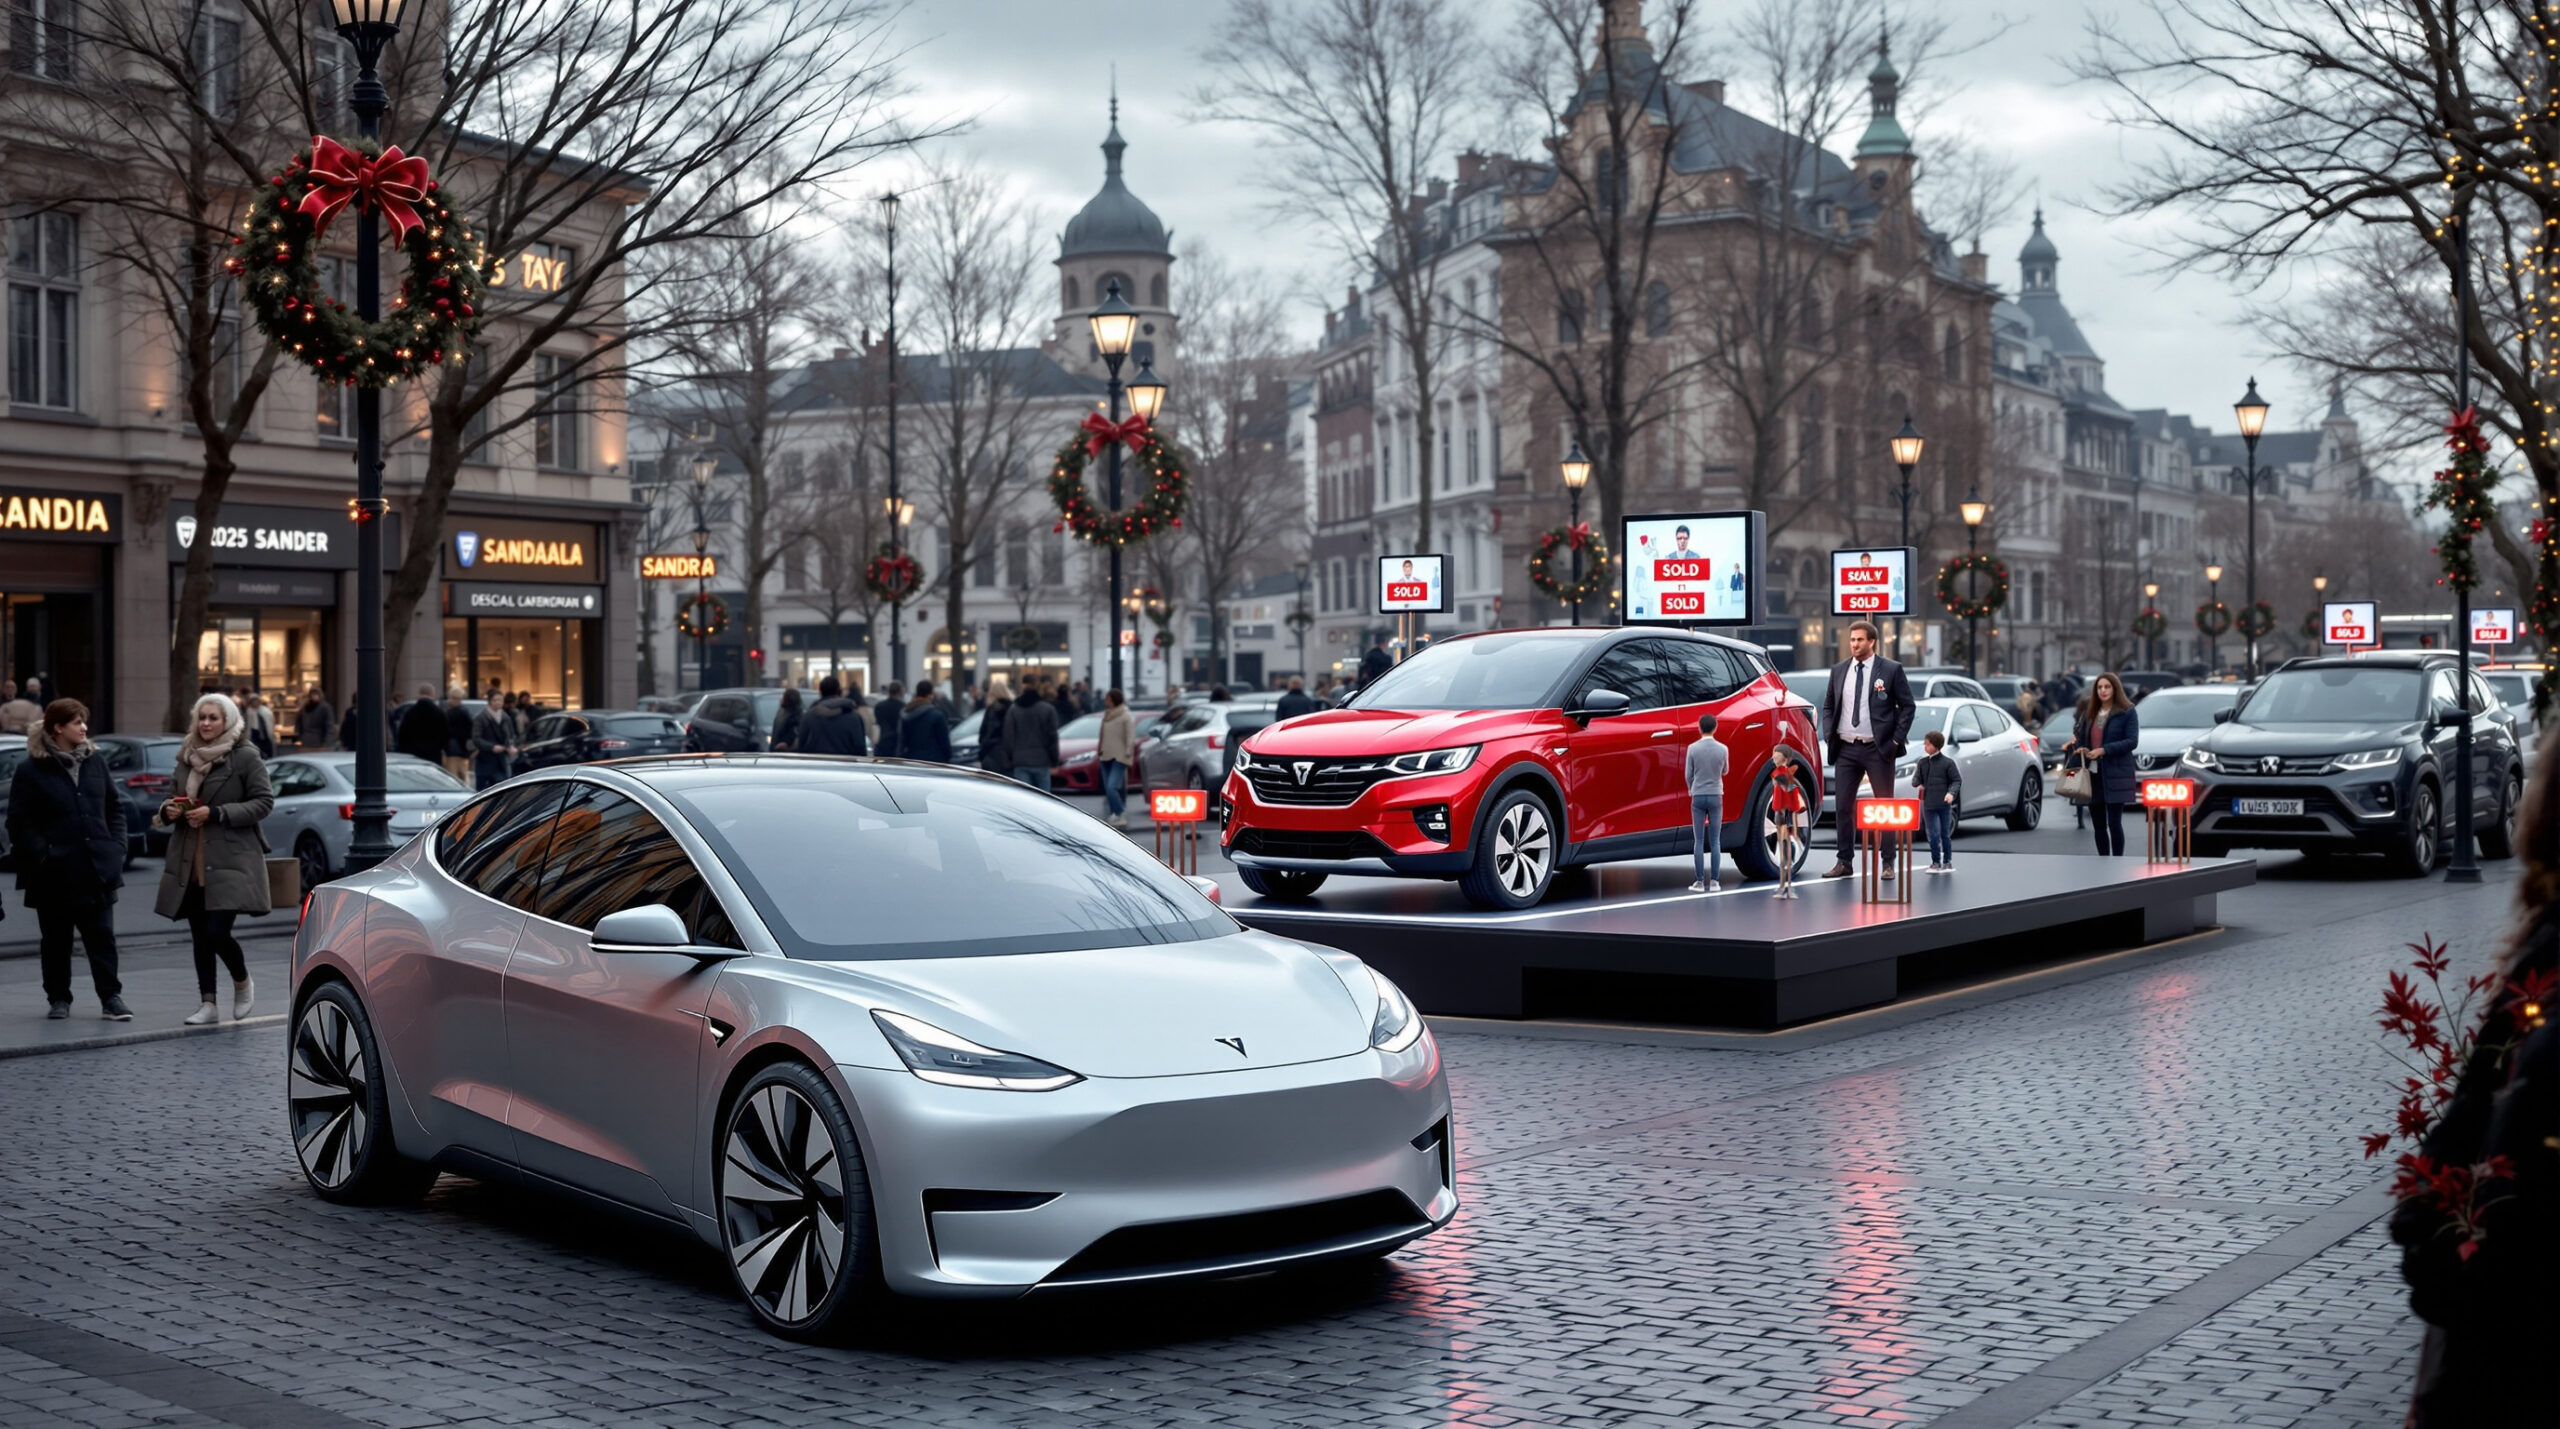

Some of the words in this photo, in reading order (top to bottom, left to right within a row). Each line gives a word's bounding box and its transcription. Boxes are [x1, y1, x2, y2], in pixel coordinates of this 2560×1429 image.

[254, 528, 328, 552] SANDER
[483, 538, 583, 566] SANDAALA
[642, 556, 715, 577] SANDRA
[1662, 563, 1699, 577] SOLD
[1393, 586, 1420, 597] SOLD
[1665, 597, 1698, 610] SOLD
[1849, 596, 1879, 609] SOLD
[2146, 783, 2188, 801] SOLD
[1155, 795, 1197, 814] SOLD
[1863, 804, 1913, 825] SOLD
